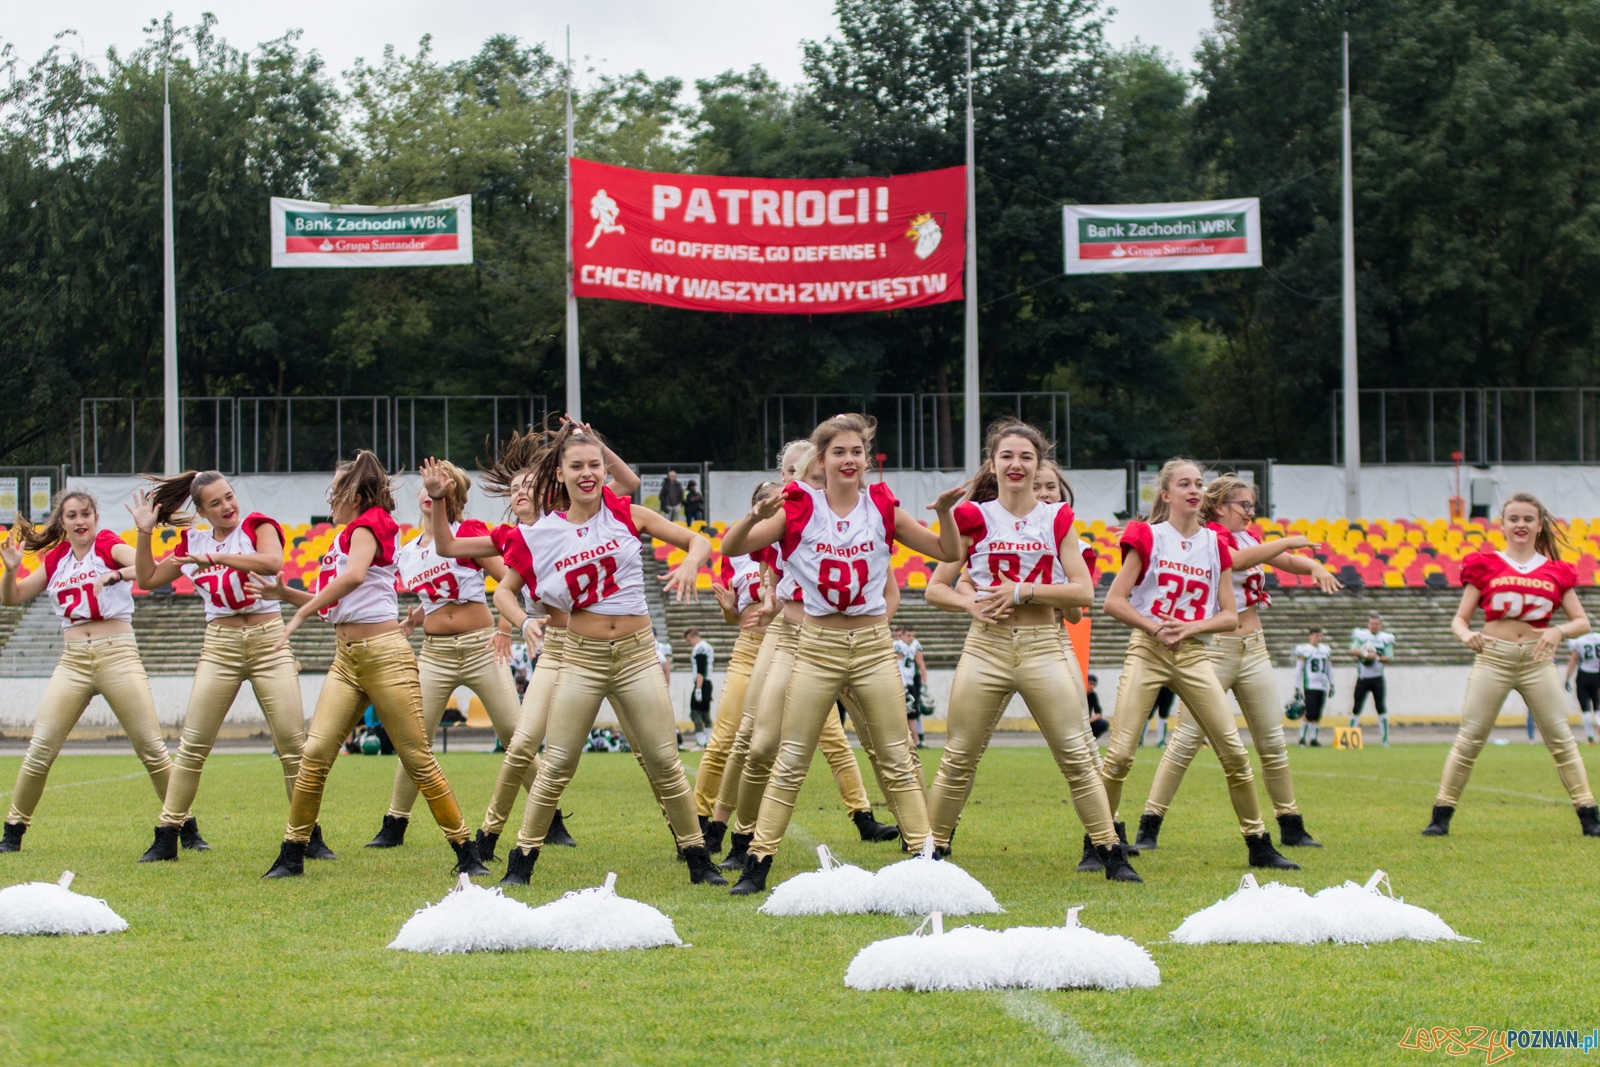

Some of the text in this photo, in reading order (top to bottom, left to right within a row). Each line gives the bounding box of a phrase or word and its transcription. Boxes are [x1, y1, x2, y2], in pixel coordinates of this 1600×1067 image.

[652, 184, 889, 227] PATRIOCI!
[295, 215, 448, 232] Bank Zachodni WBK
[1087, 219, 1237, 238] Bank Zachodni WBK
[335, 238, 426, 253] Grupa Santander
[650, 238, 676, 254] GO
[765, 245, 790, 263] GO
[1127, 243, 1215, 257] Grupa Santander
[580, 264, 947, 304] CHCEMY WASZYCH ZWYCIĘSTW
[554, 538, 620, 572] PATRIOCI
[407, 561, 451, 589] PATRIOCI
[1491, 576, 1555, 593] PATRIOCI
[57, 583, 104, 624] 21
[1150, 572, 1210, 622] 33
[1340, 730, 1360, 749] 40
